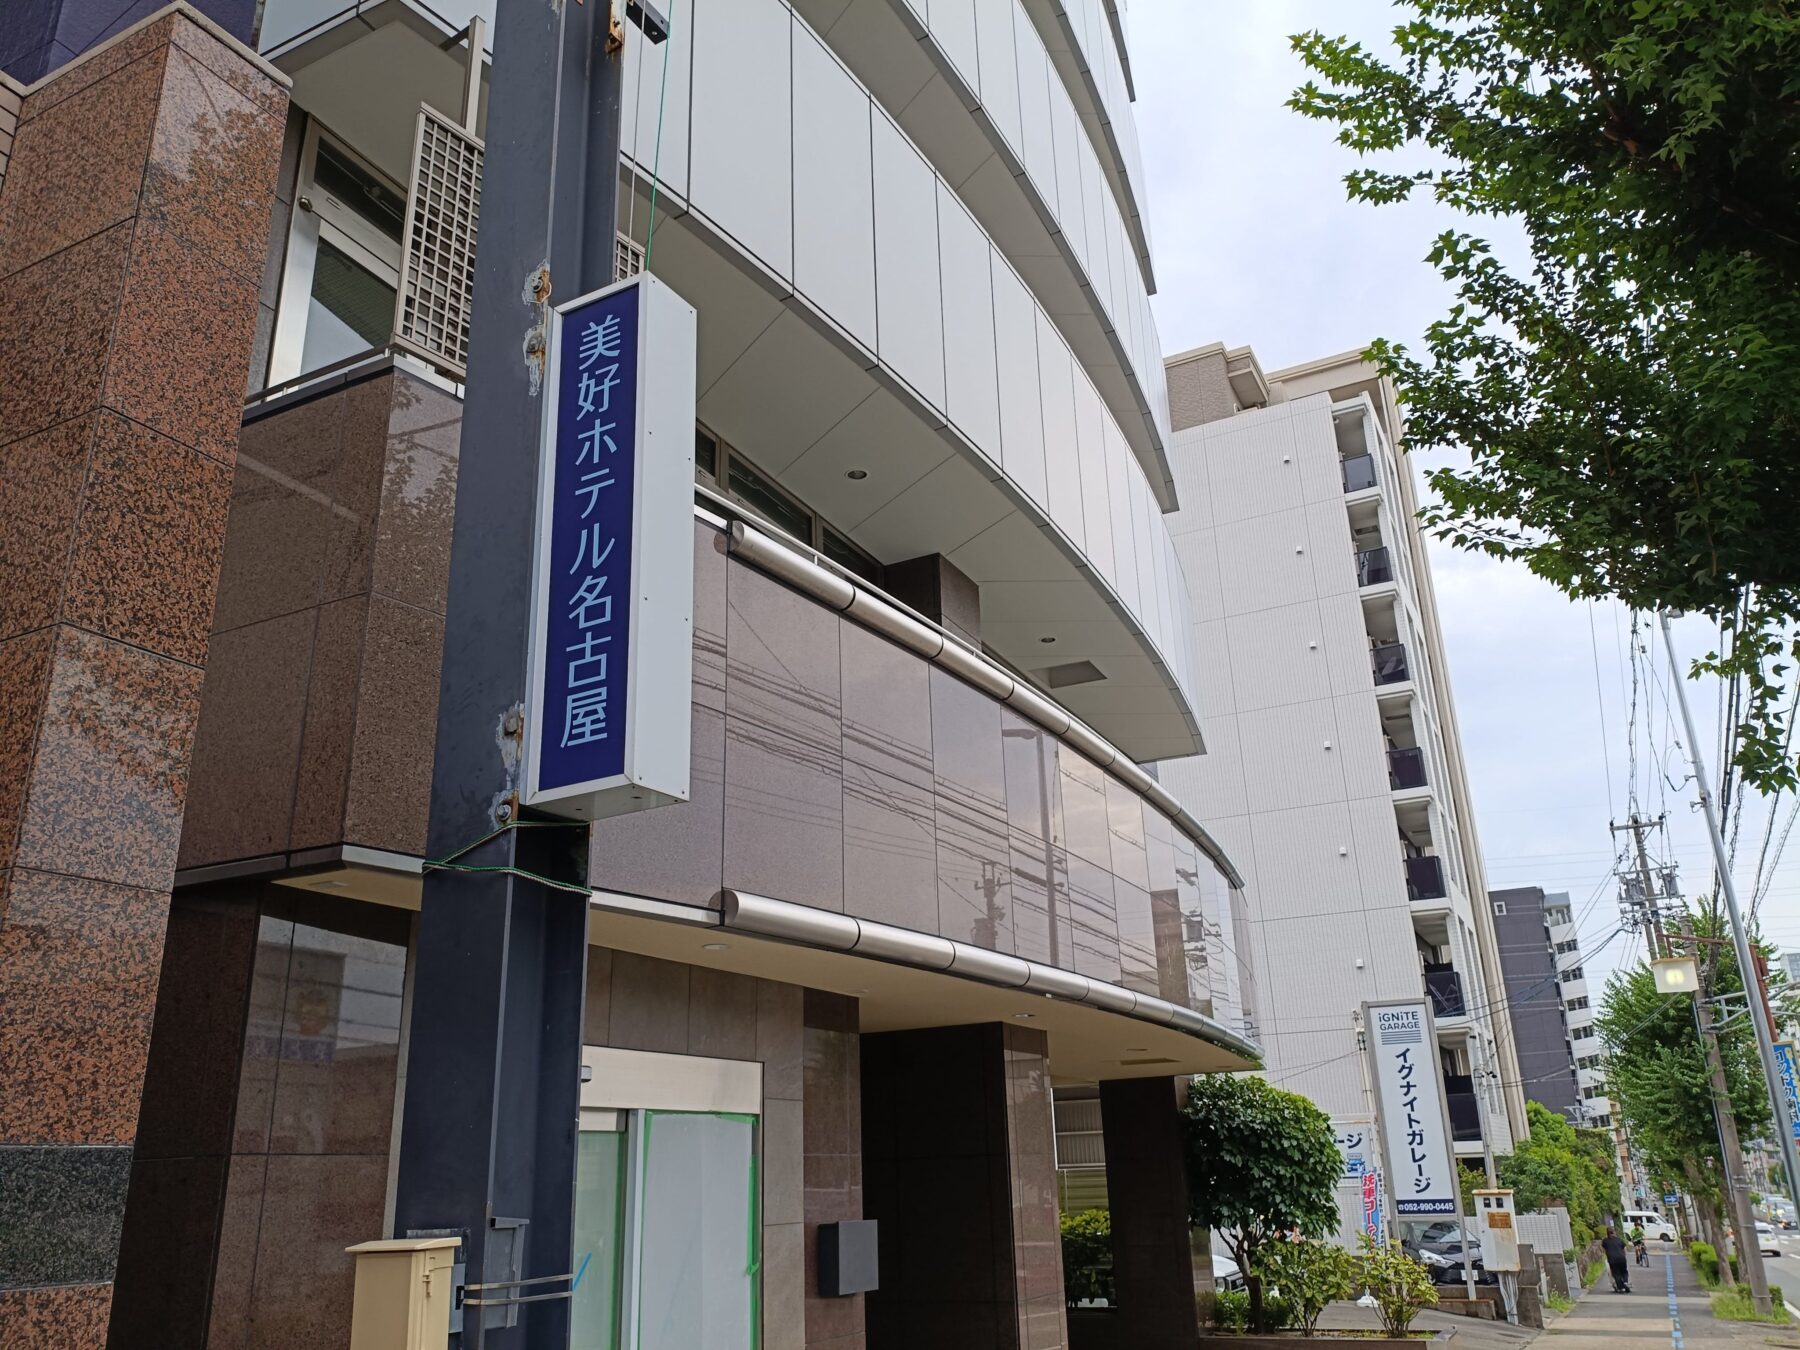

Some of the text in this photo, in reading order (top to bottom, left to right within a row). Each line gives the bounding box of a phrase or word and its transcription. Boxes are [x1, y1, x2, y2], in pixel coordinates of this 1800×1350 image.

[560, 314, 621, 748] 美好ホテル名古屋
[1379, 1021, 1421, 1031] GARAGE
[1395, 1048, 1431, 1194] イグナイトガレージ
[1404, 1202, 1454, 1211] 052-990-0445
